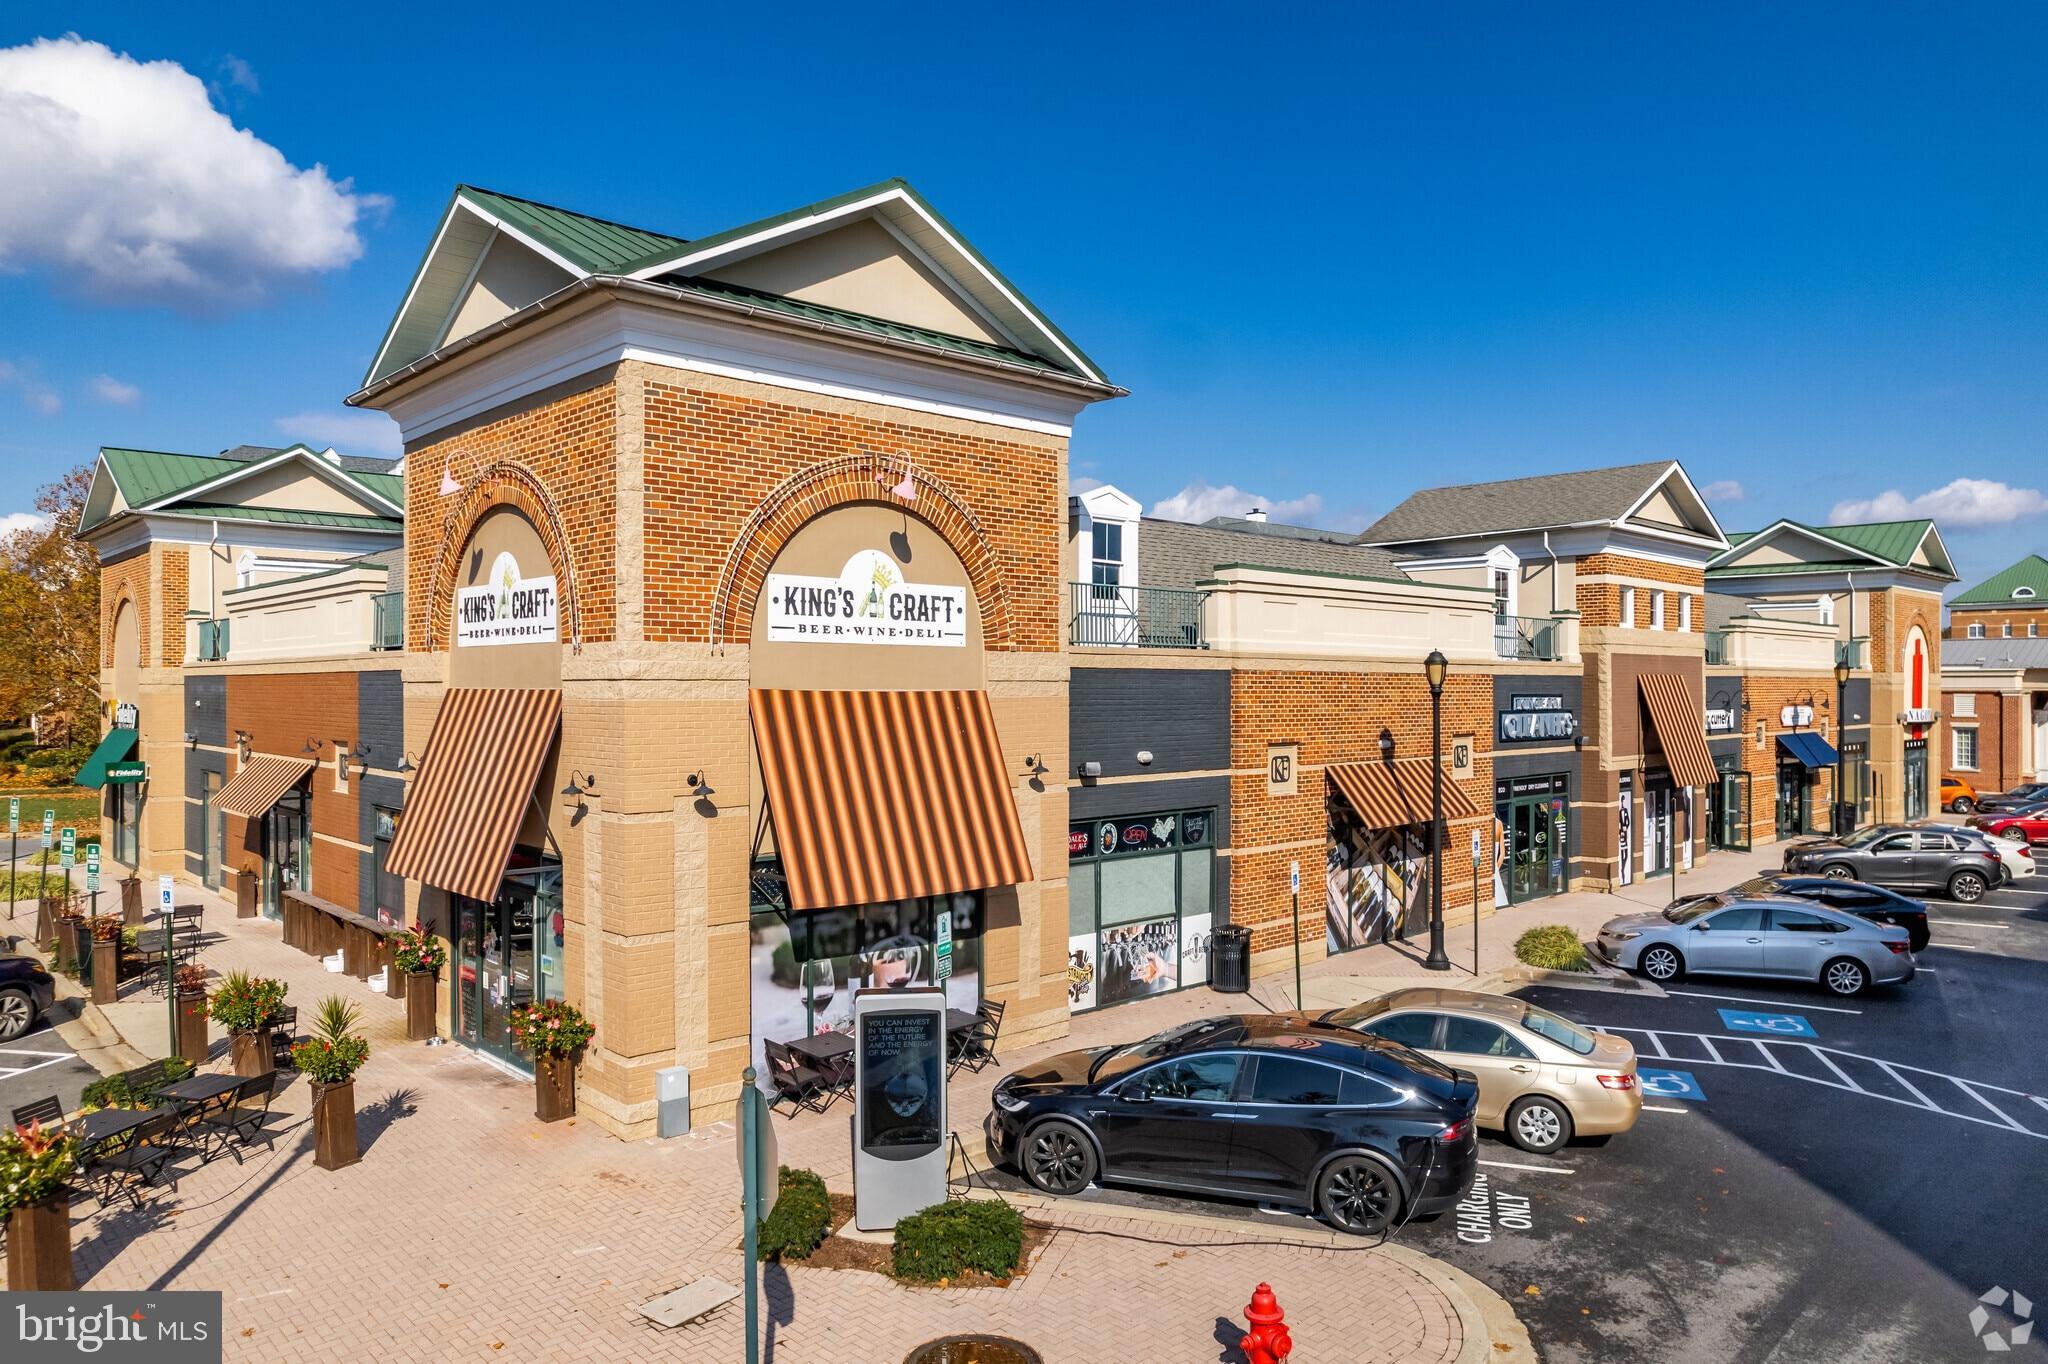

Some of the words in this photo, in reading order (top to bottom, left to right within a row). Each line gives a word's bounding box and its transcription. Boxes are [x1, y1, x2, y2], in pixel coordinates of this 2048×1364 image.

[464, 592, 496, 624] KING'S
[512, 587, 550, 620] CRAFT
[784, 585, 855, 618] KING'S
[889, 593, 954, 623] CRAFT
[469, 629, 490, 639] BEER
[494, 627, 516, 637] WINE
[521, 625, 542, 635] DELI
[798, 624, 844, 635] BEER
[853, 626, 897, 637] WINE
[905, 628, 942, 638] DELI
[115, 769, 144, 777] Fidelity
[1125, 828, 1147, 842] OPEN
[903, 1040, 933, 1048] ENERGY
[1495, 1191, 1533, 1229] ONLY
